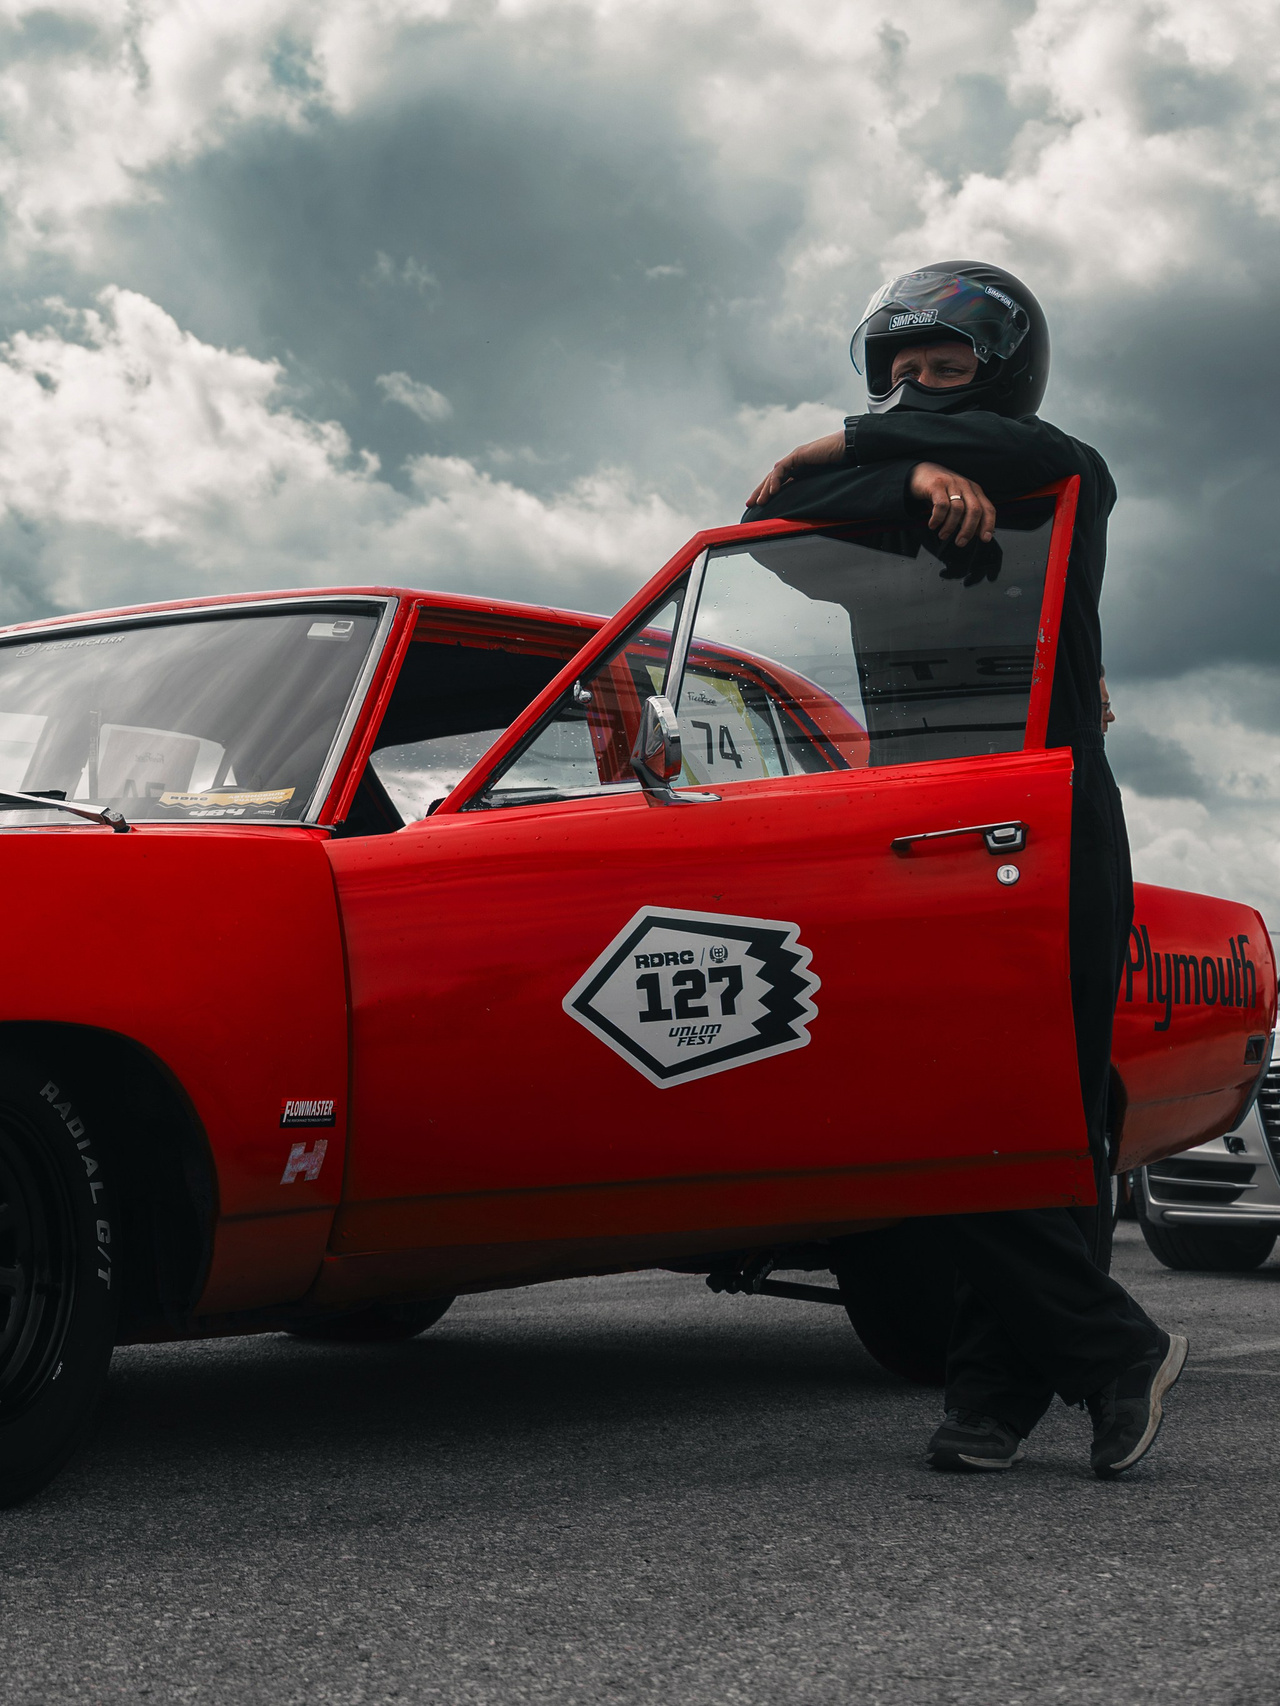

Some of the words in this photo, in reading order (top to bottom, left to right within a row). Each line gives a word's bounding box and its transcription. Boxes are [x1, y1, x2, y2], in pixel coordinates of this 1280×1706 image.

[988, 287, 1011, 306] SIMPSON
[891, 310, 934, 328] SIMPSON
[691, 720, 743, 769] 74
[634, 949, 695, 969] RDRC
[1125, 924, 1256, 1031] Plymouth
[635, 964, 744, 1023] 127
[676, 1034, 717, 1047] FEST
[283, 1100, 334, 1123] FLOWMASTER
[40, 1080, 104, 1205] RADIAL
[96, 1219, 113, 1290] G/T
